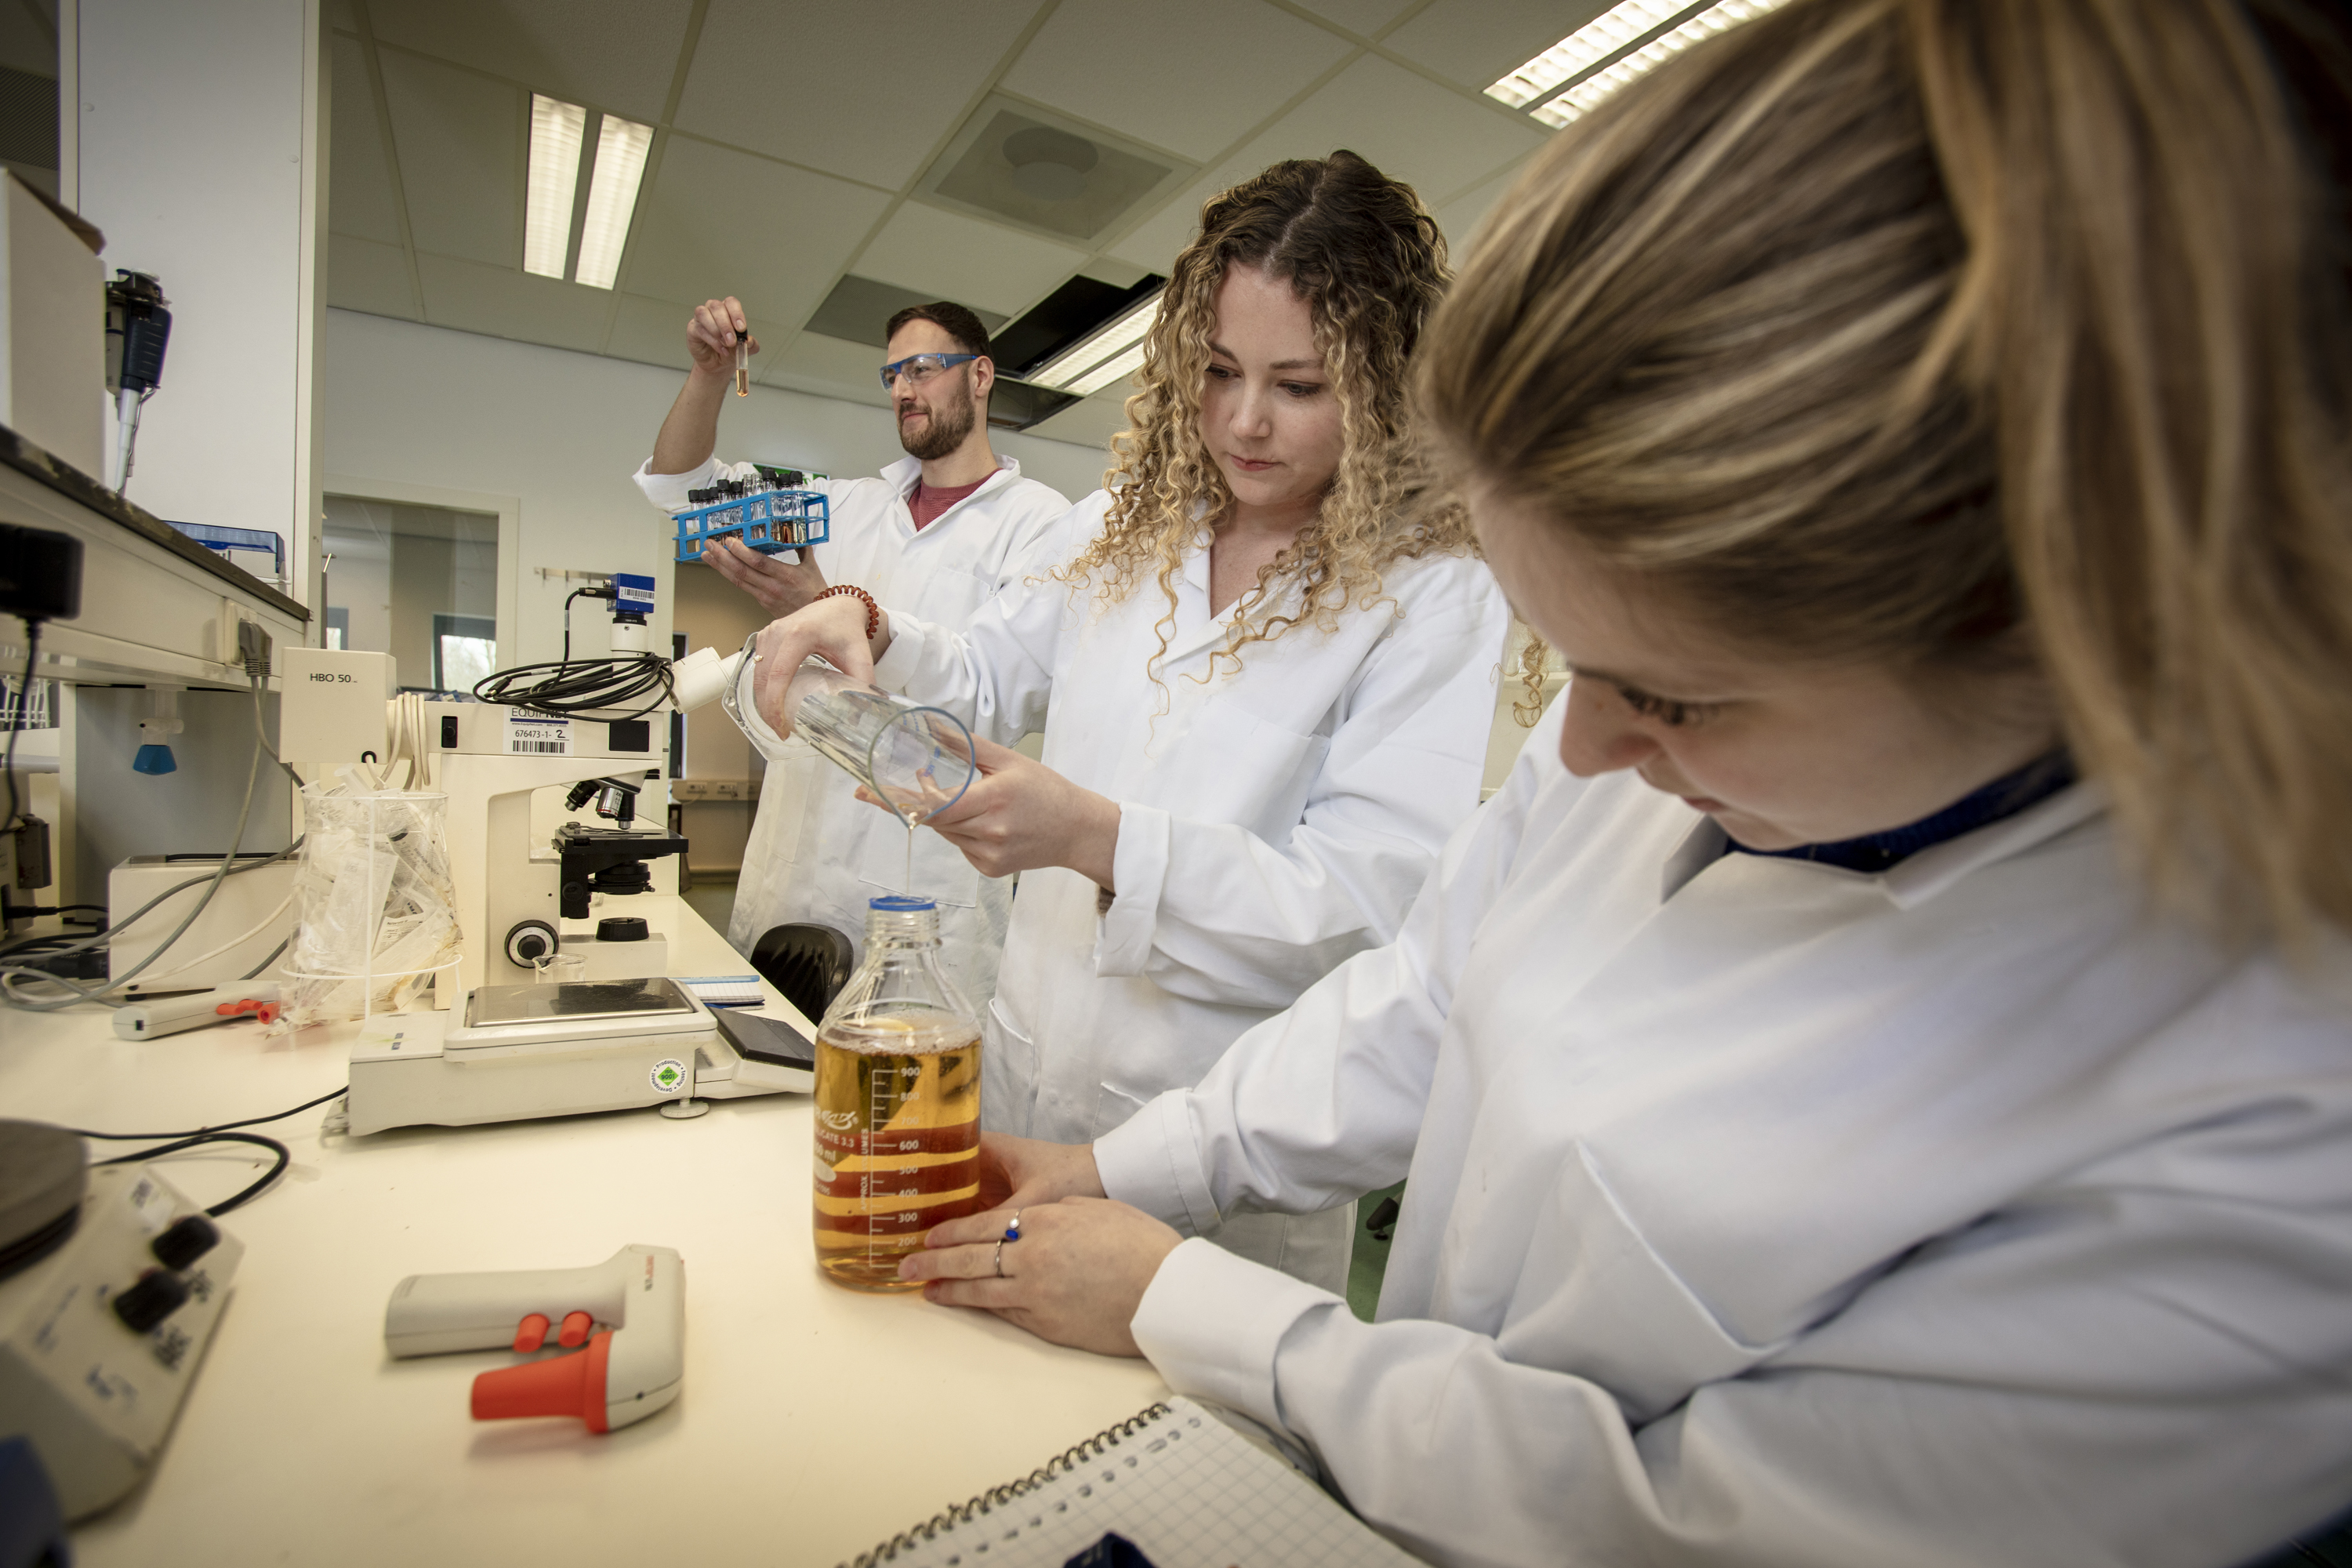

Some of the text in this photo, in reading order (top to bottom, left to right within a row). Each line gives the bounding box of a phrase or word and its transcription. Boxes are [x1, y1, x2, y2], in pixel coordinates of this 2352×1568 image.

[310, 673, 335, 683] HBO
[338, 674, 351, 683] 50
[556, 729, 566, 739] 2
[655, 1060, 681, 1069] Production
[901, 1066, 920, 1077] 900
[651, 1073, 673, 1092] Development
[676, 1069, 686, 1087] Testing
[900, 1092, 920, 1102] 800
[901, 1116, 919, 1126] 700
[840, 1136, 855, 1148] 3.3
[899, 1139, 920, 1151] 600
[899, 1165, 919, 1175] 500
[898, 1188, 918, 1198] 400
[898, 1212, 918, 1223] 300
[898, 1236, 917, 1247] 200
